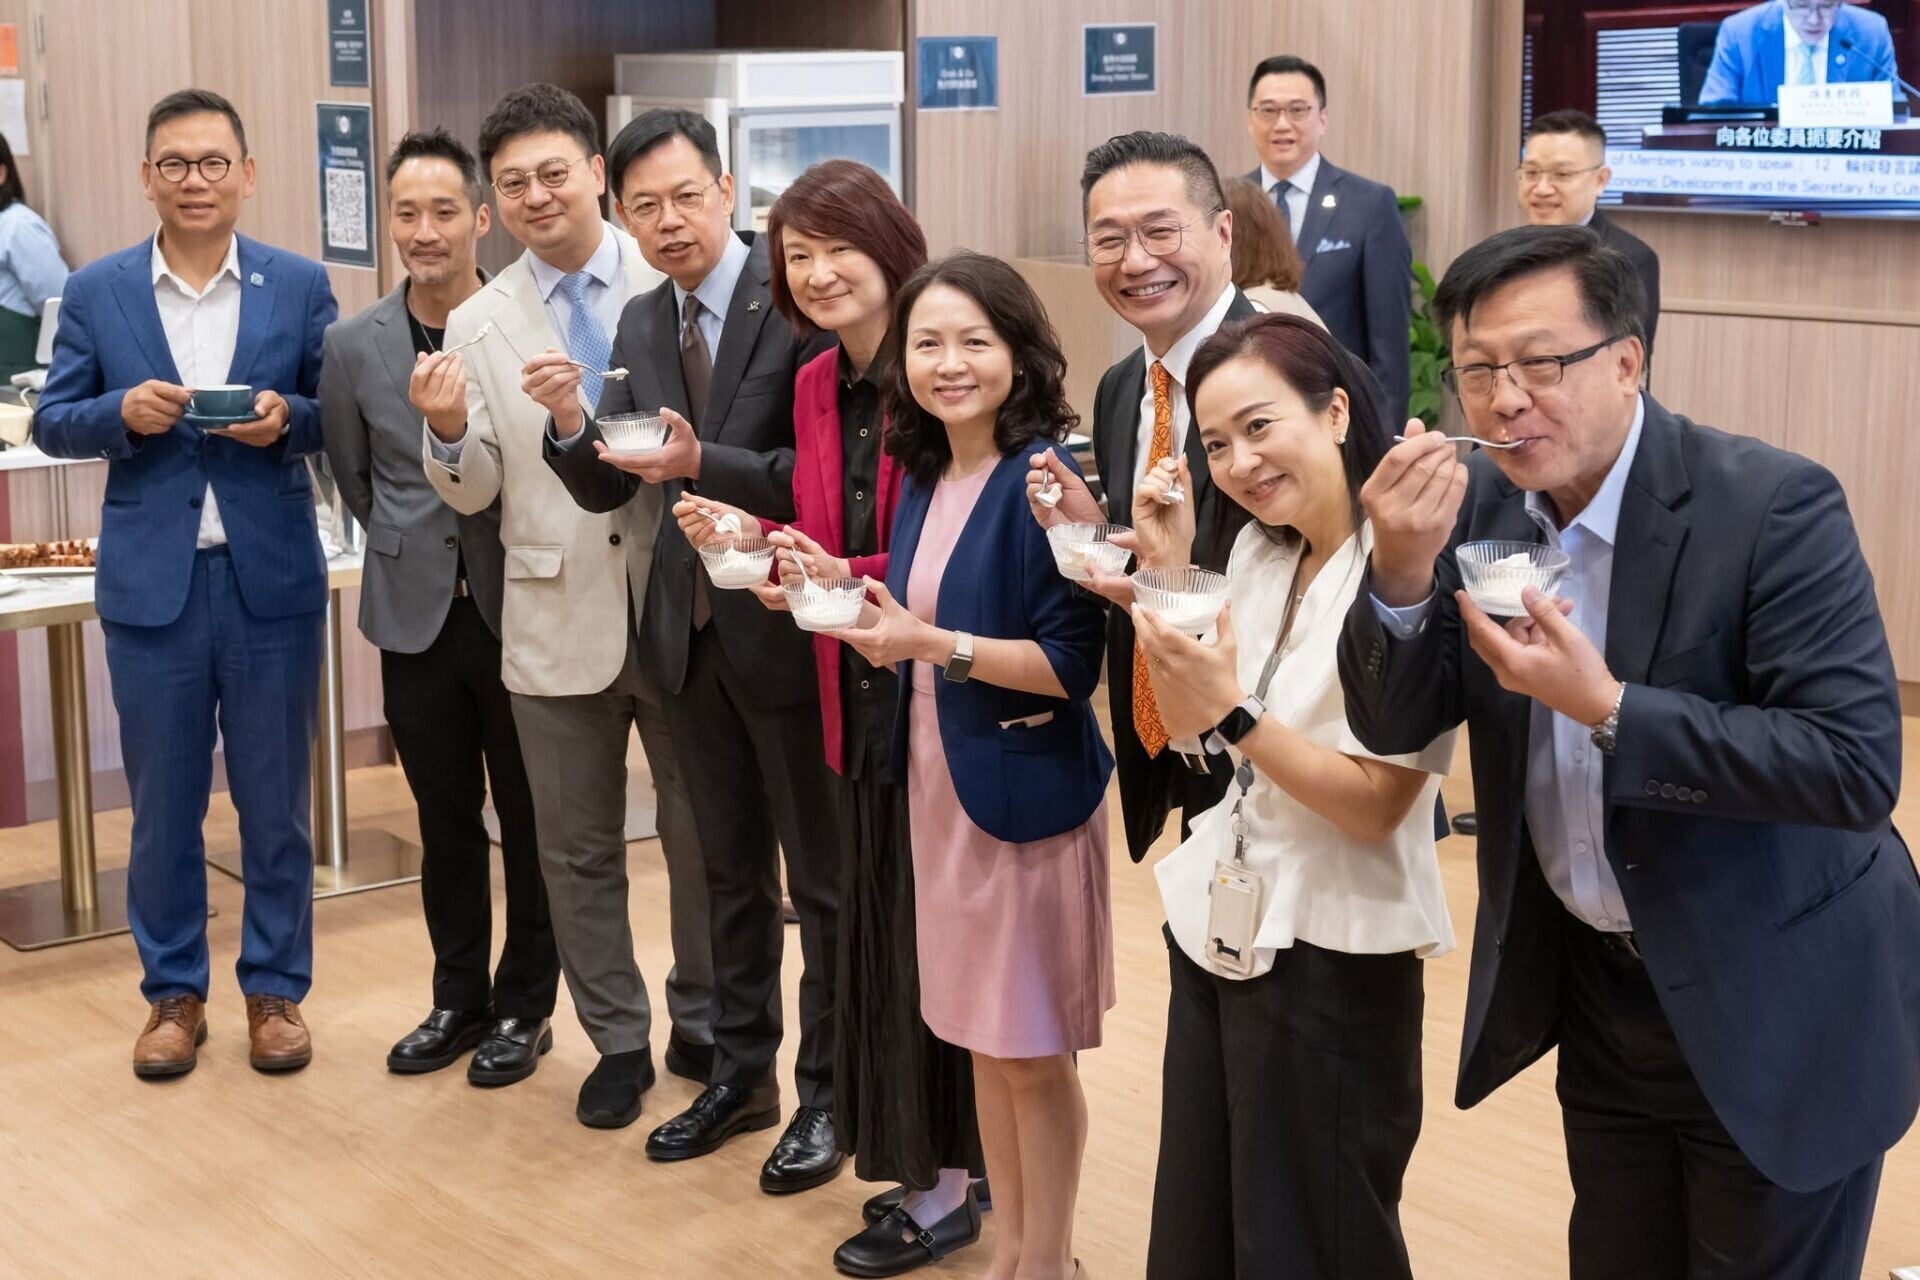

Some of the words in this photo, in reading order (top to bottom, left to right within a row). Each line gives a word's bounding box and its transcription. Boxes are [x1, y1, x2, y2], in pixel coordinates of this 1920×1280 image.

[1629, 153, 1686, 168] Members
[1690, 156, 1735, 171] waiting
[1740, 156, 1753, 168] to
[1758, 158, 1793, 172] speak
[1609, 175, 1658, 187] conomic
[1662, 171, 1744, 188] Development
[1749, 177, 1773, 191] and
[1777, 177, 1798, 191] the
[1802, 177, 1864, 195] Secretary
[1869, 178, 1887, 193] for
